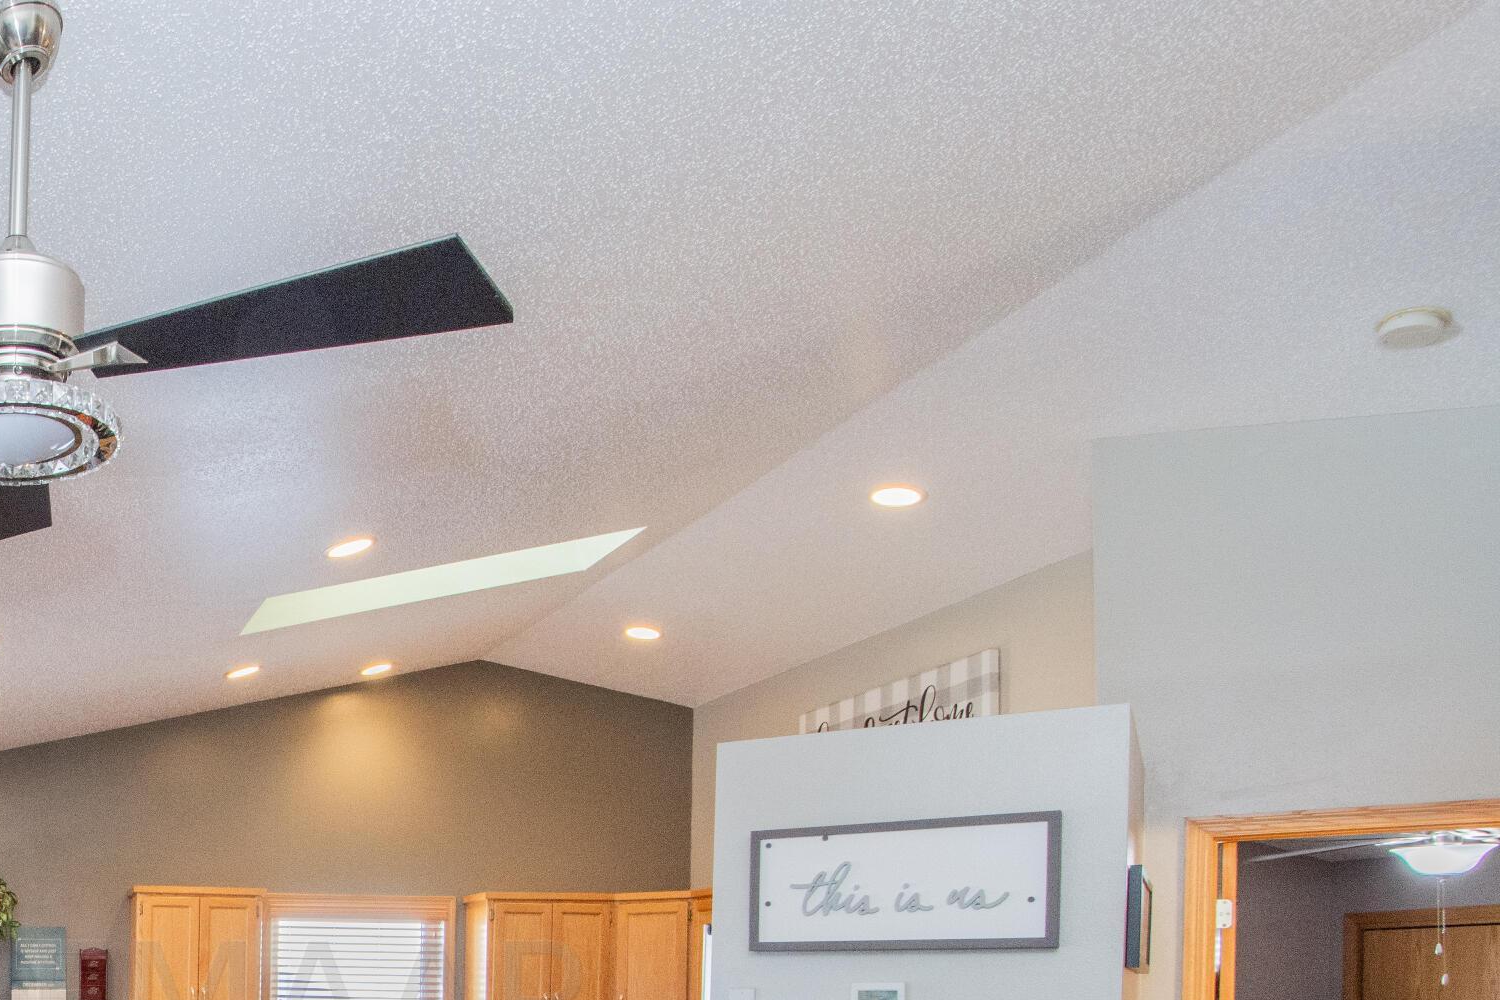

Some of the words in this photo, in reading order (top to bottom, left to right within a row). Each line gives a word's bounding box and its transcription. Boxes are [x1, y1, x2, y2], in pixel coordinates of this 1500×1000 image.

[790, 861, 880, 917] this
[894, 883, 934, 913] is
[946, 886, 1011, 911] us
